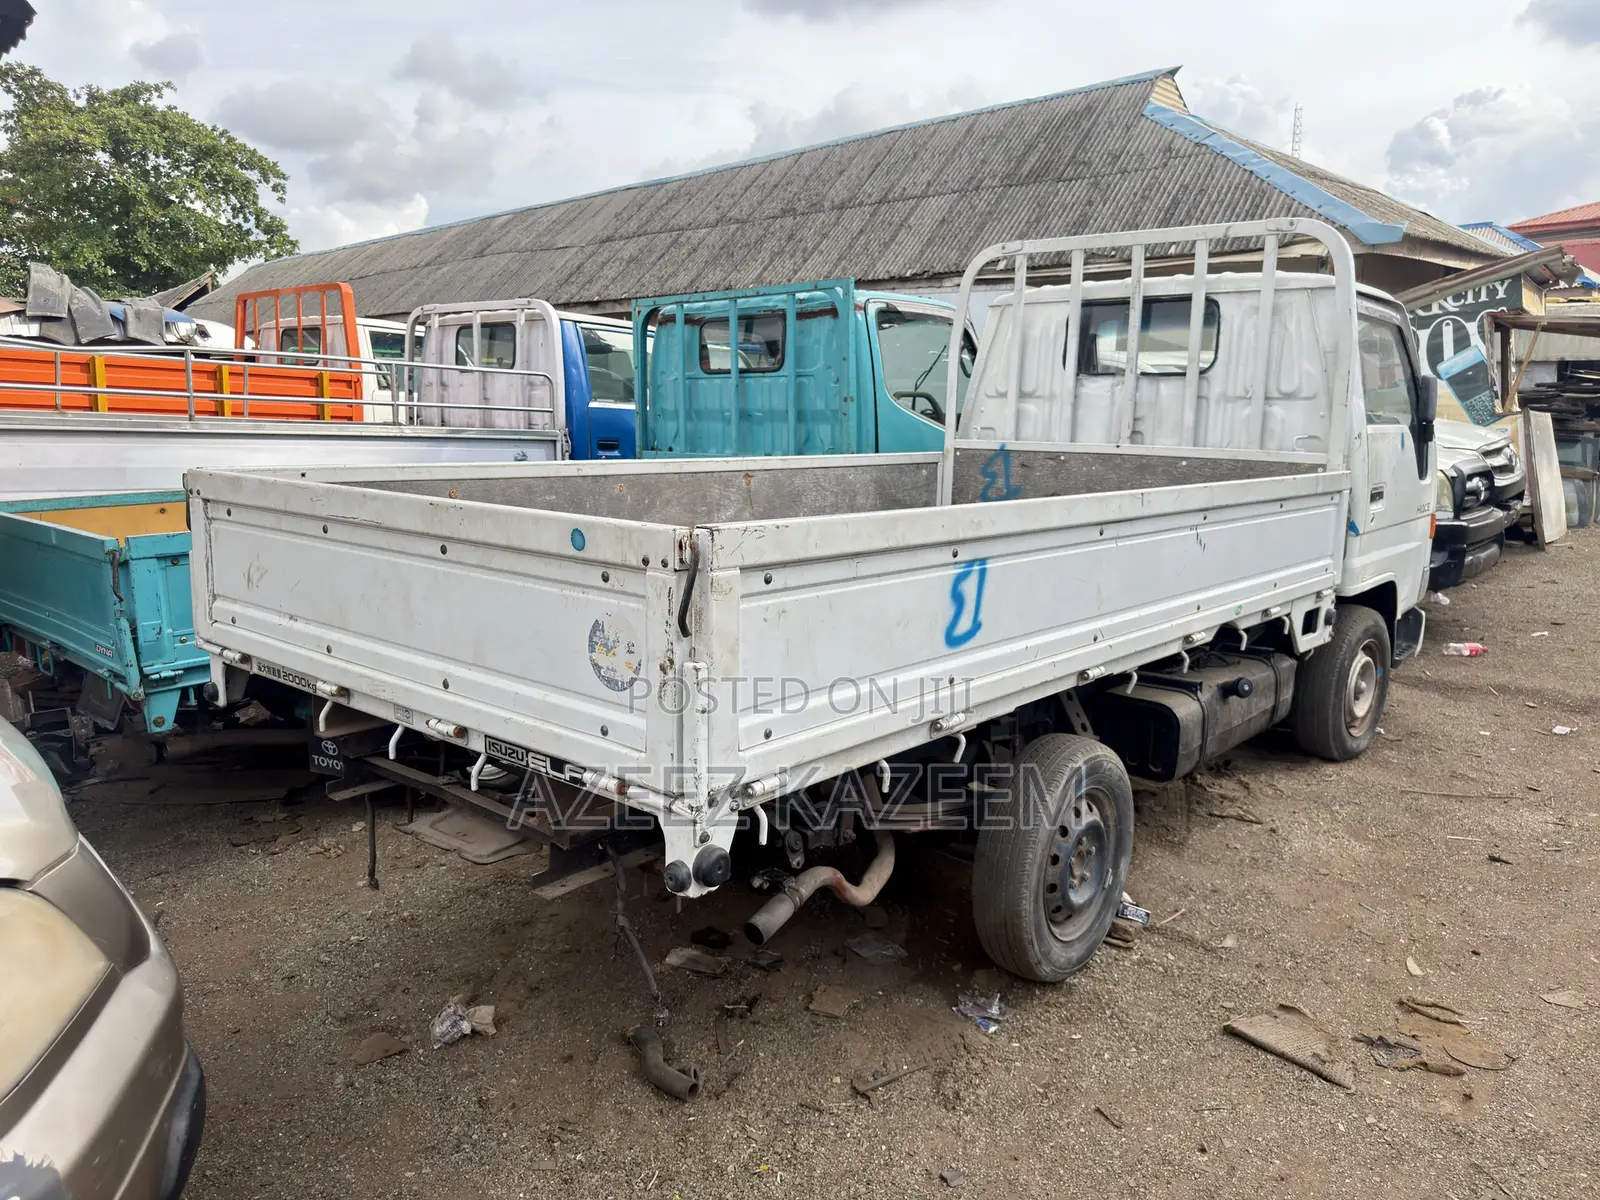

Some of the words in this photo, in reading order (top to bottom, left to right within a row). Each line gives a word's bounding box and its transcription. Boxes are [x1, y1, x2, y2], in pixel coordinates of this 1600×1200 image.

[312, 754, 344, 770] TOYO
[486, 739, 526, 764] ISUZU
[527, 751, 586, 781] ELF
